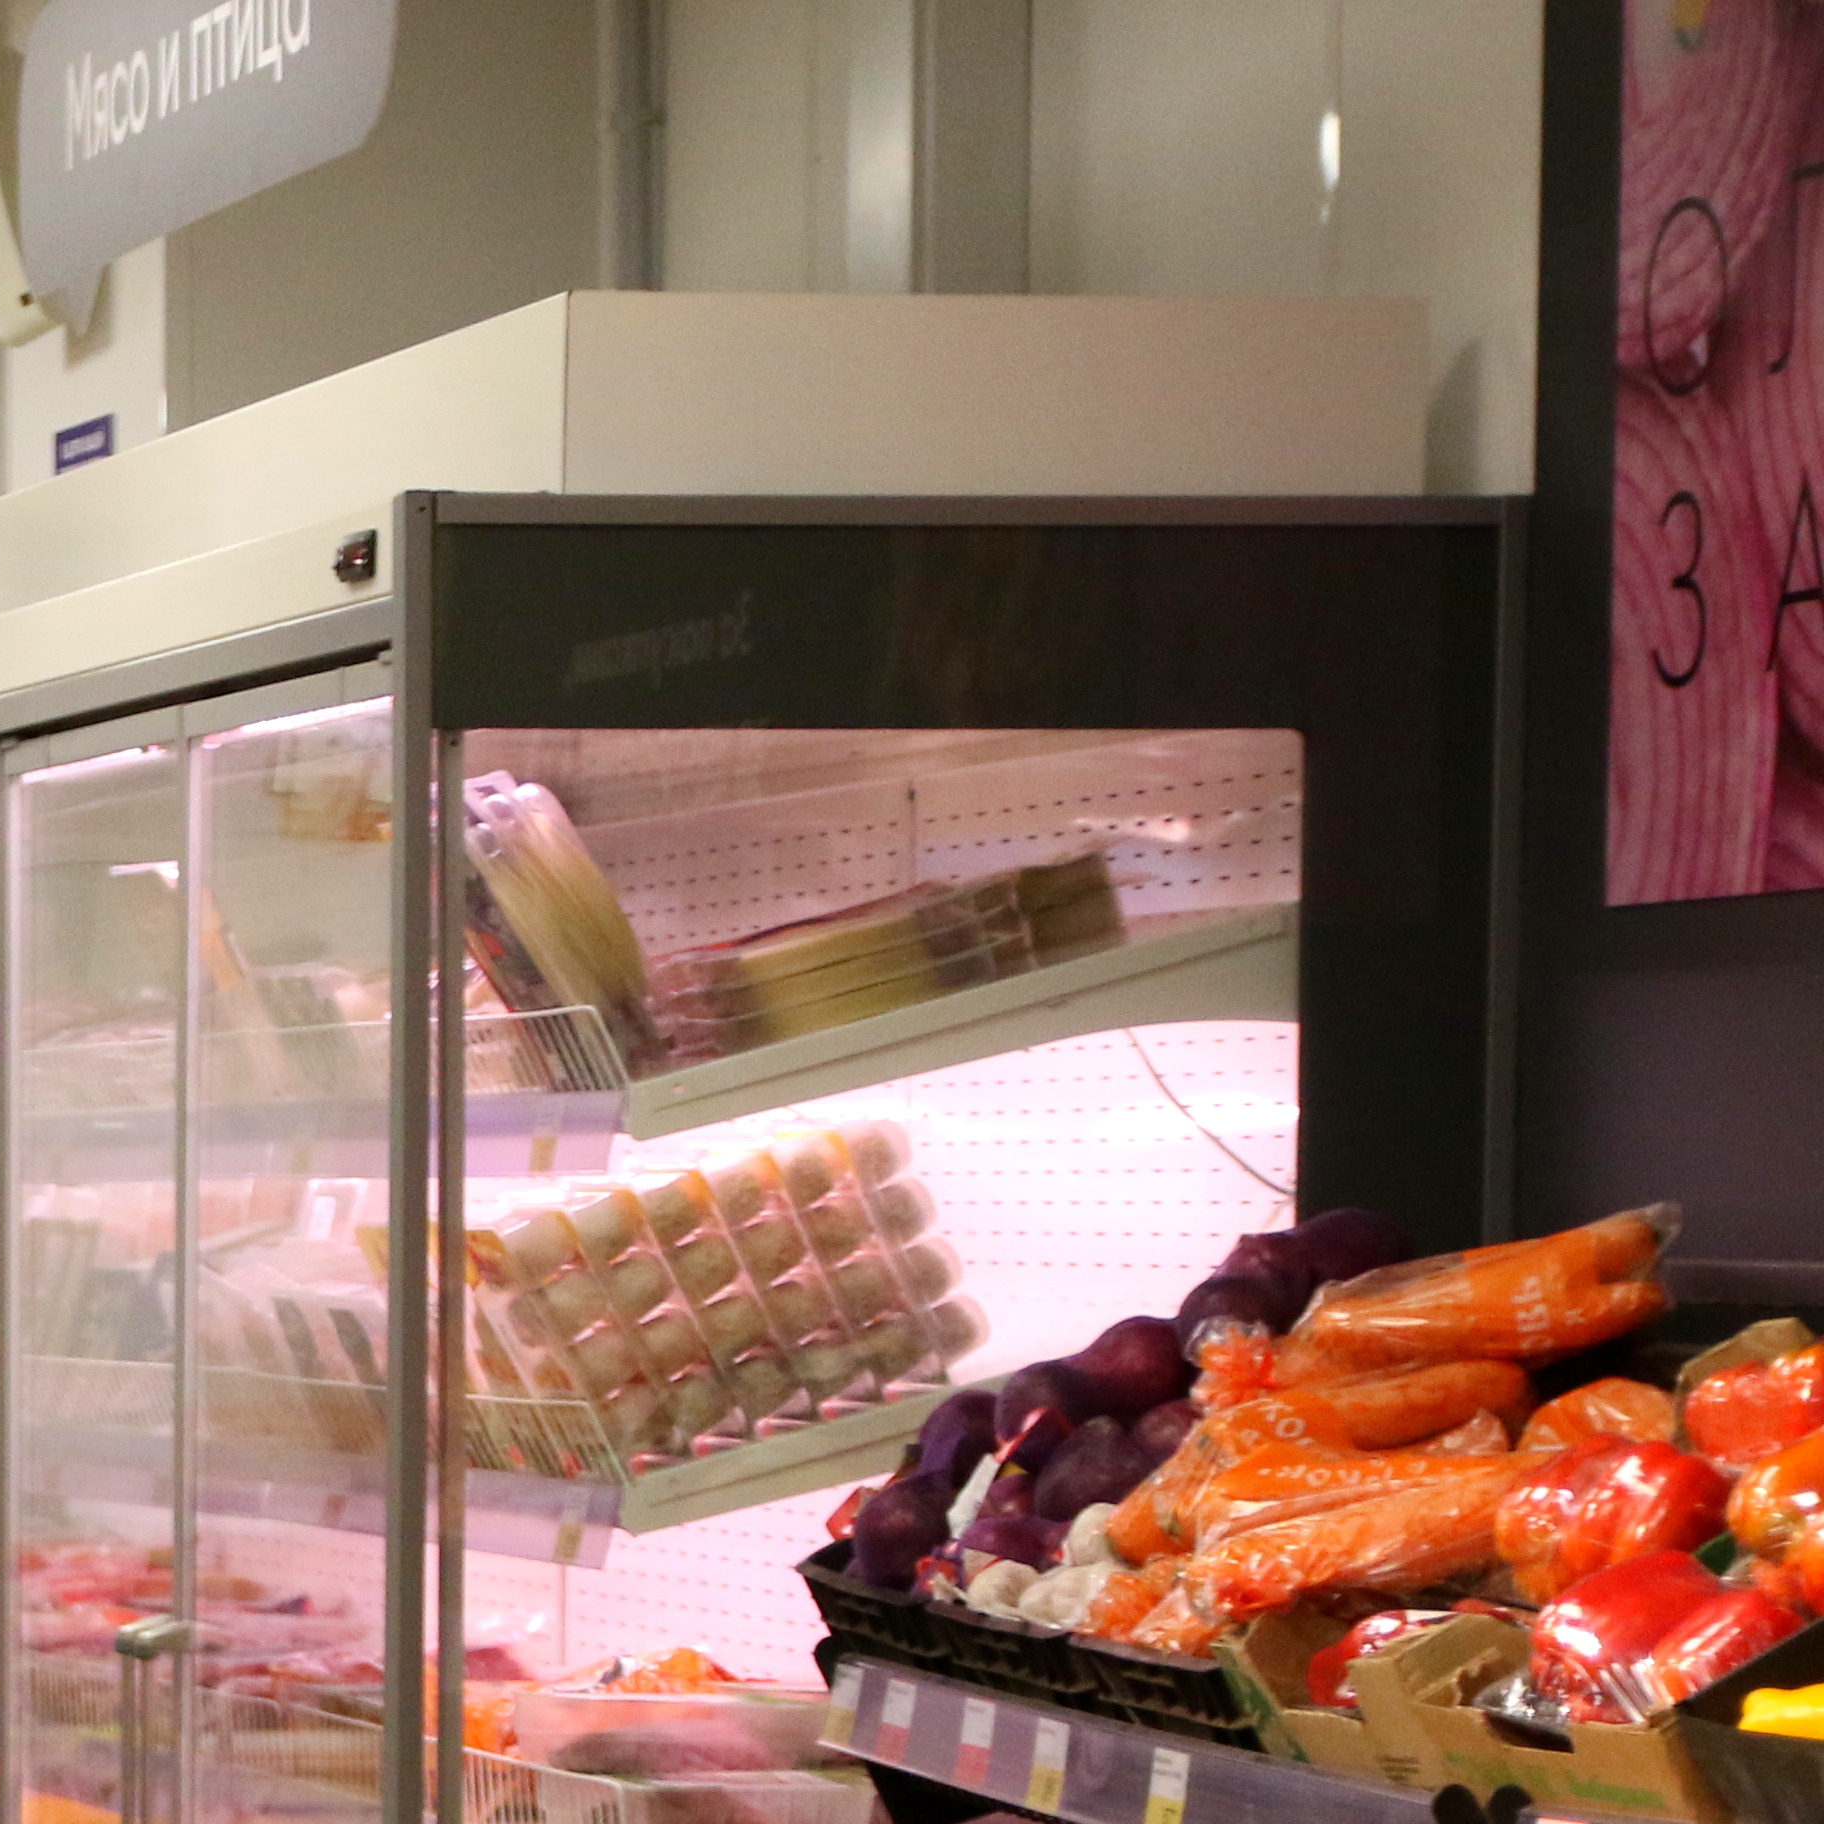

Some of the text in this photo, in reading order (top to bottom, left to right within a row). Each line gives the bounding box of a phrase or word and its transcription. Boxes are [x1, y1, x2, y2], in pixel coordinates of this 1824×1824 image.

[65, 0, 310, 171] Мясо и птица
